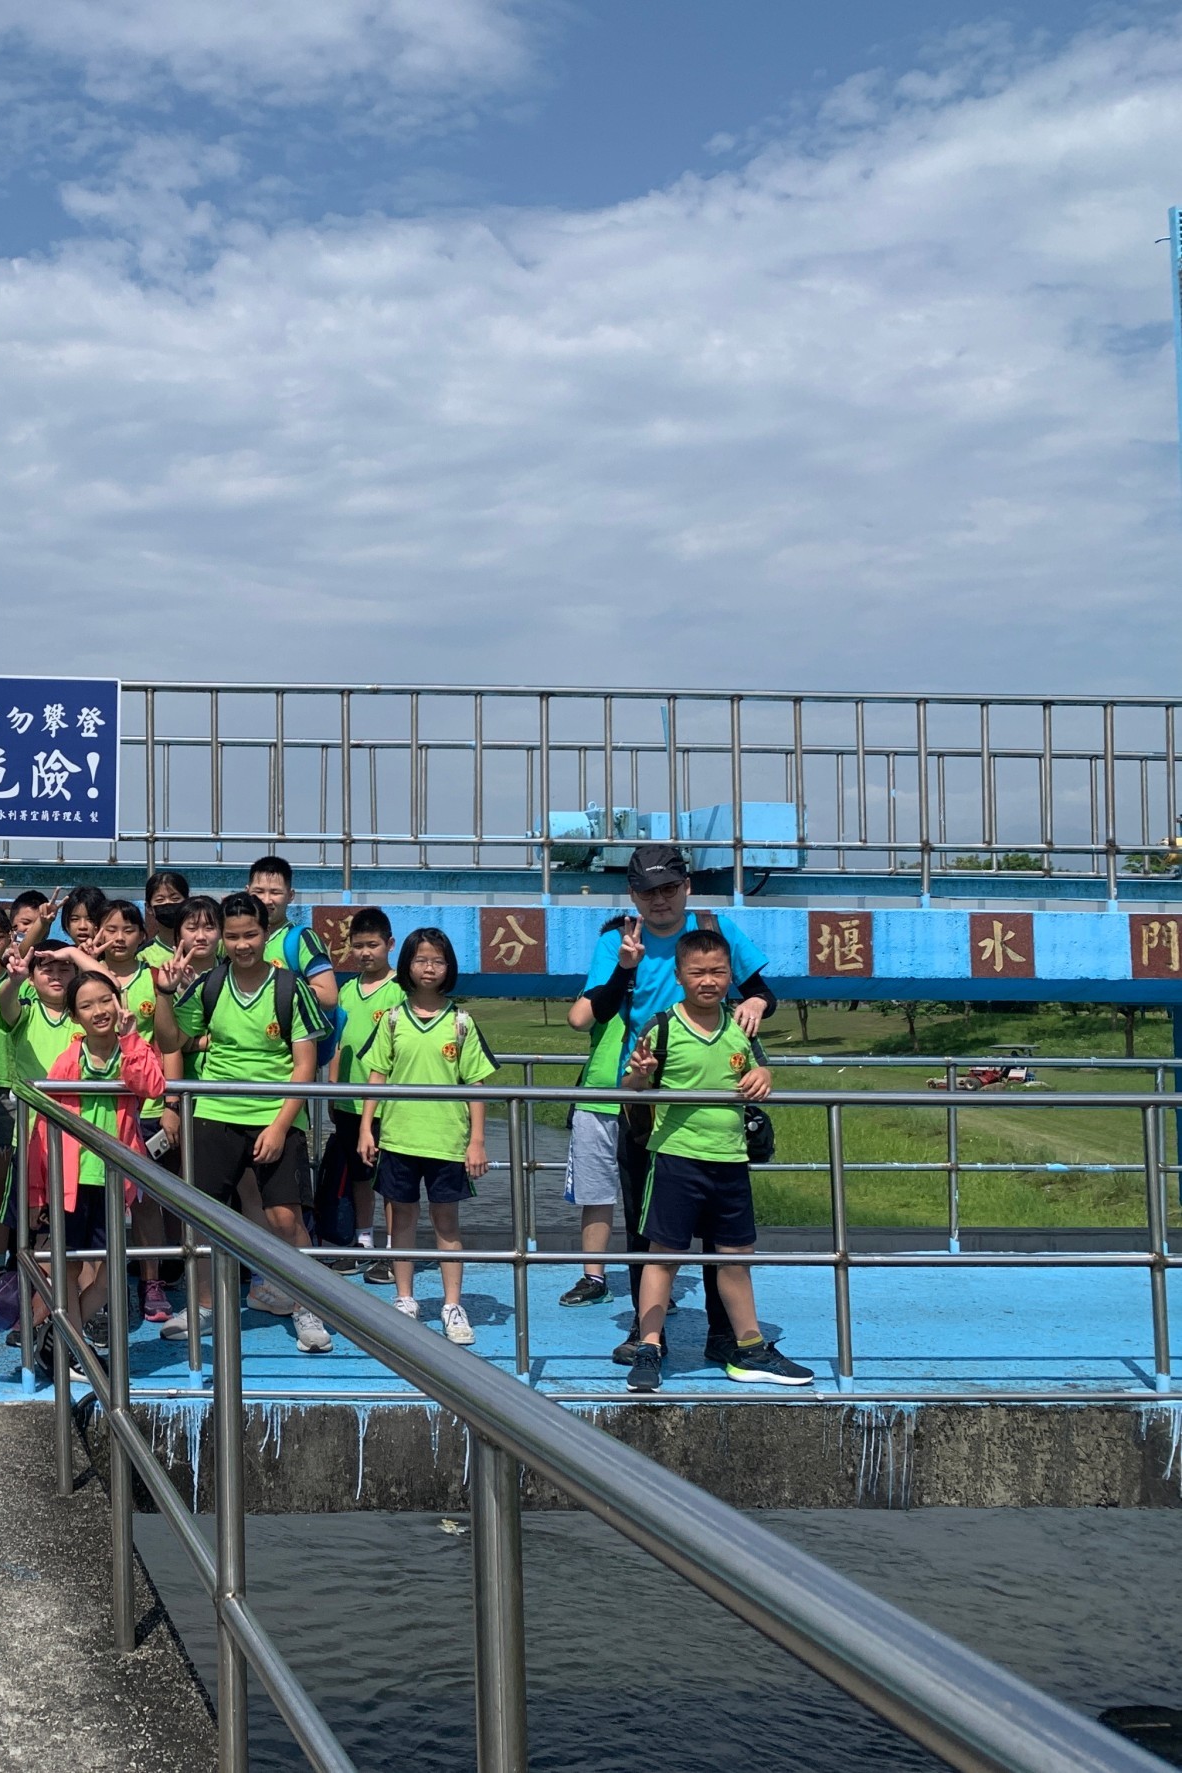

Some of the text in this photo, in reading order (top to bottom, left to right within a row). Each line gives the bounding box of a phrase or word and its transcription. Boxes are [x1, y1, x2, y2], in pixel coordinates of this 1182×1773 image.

[489, 914, 539, 967] 分
[816, 918, 865, 973] 堰
[978, 919, 1027, 973] 水
[1141, 920, 1180, 972] 門
